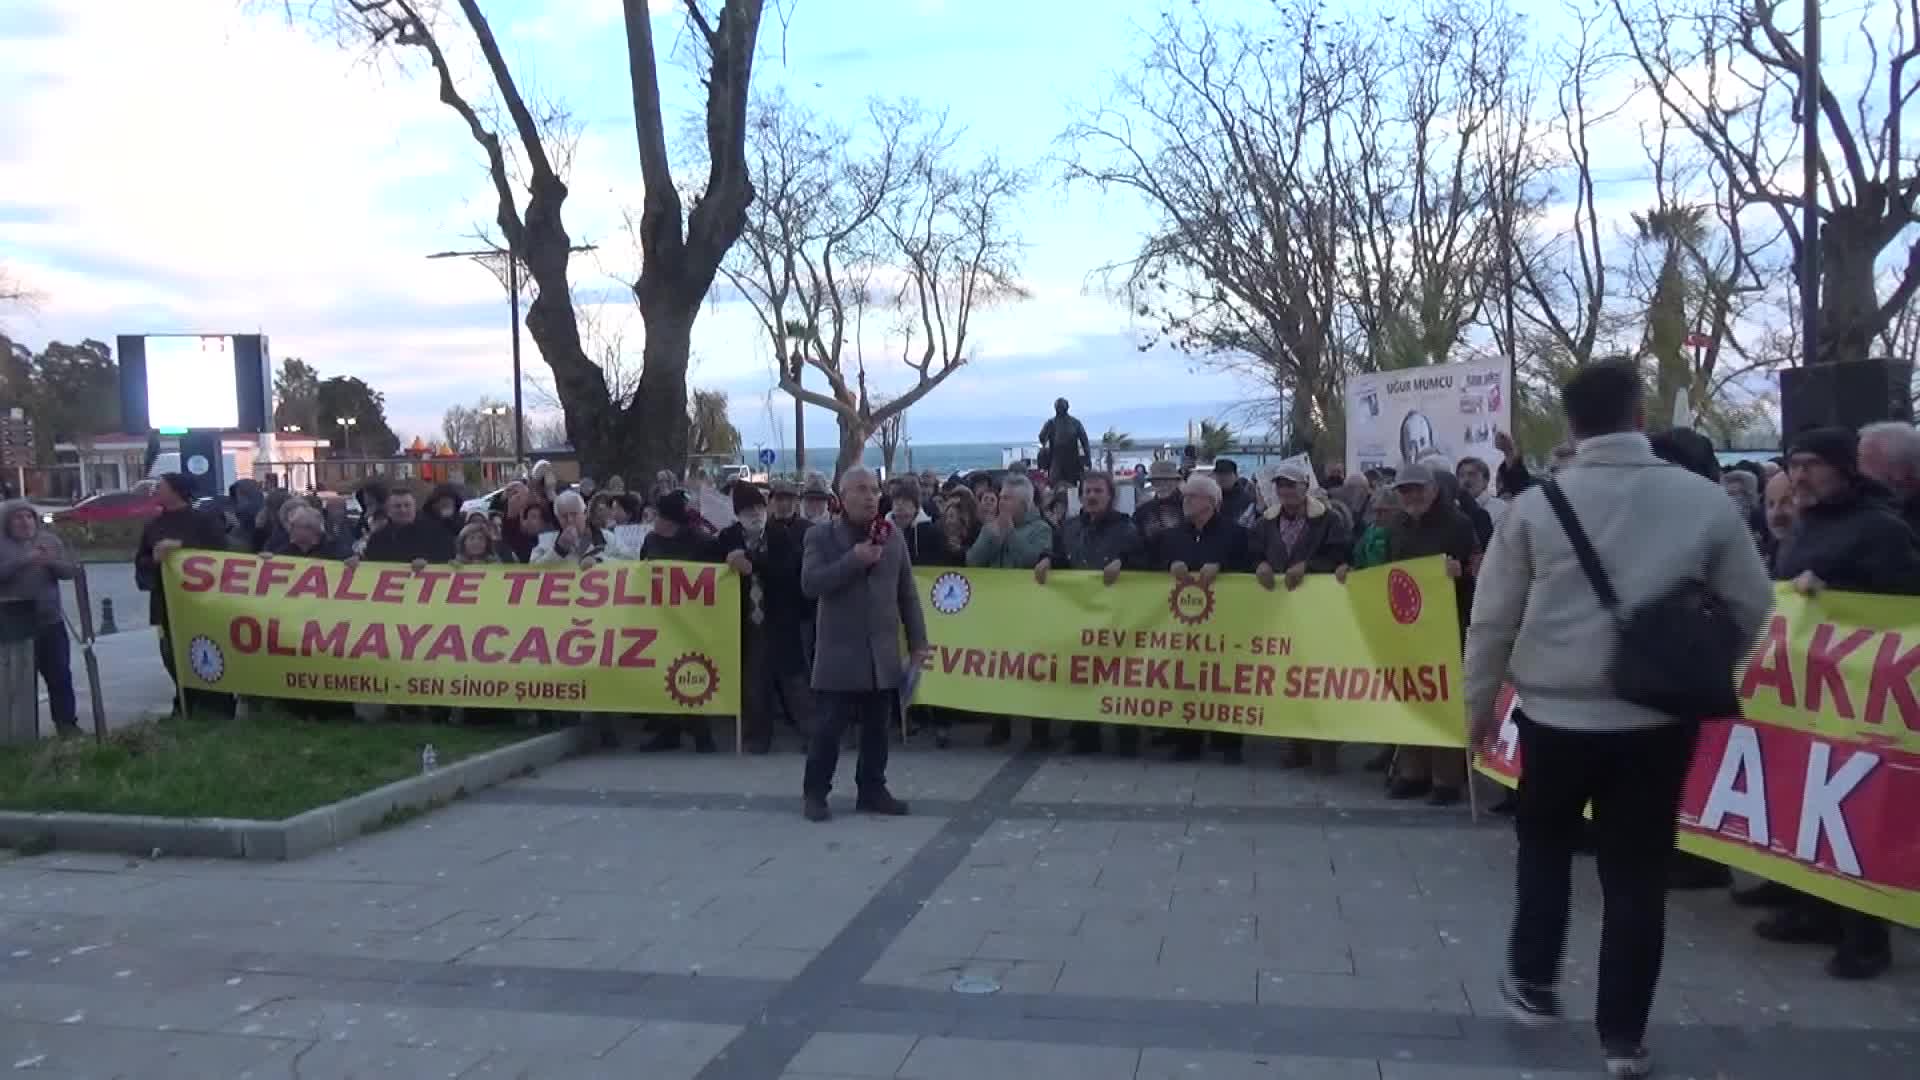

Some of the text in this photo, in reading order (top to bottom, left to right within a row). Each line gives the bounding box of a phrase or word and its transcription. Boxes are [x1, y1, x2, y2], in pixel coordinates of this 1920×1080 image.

[1413, 375, 1453, 391] MUMCU
[181, 556, 716, 608] SEFALETE TESLİM
[229, 616, 659, 668] OLMAYACAĞIZ
[1081, 629, 1127, 647] DEV
[1135, 631, 1225, 653] EMEKLİ
[1251, 636, 1291, 656] SEN
[286, 672, 318, 690] DEV
[324, 674, 389, 693] EMEKLİ
[407, 677, 444, 696] SEN
[450, 676, 509, 697] SİNOP
[515, 679, 587, 702] ŞUBESİ
[920, 645, 1449, 703] EVRİMCİ EMEKLİLER SENDİKASI
[1100, 696, 1264, 727] SİNOP ŞUBESİ
